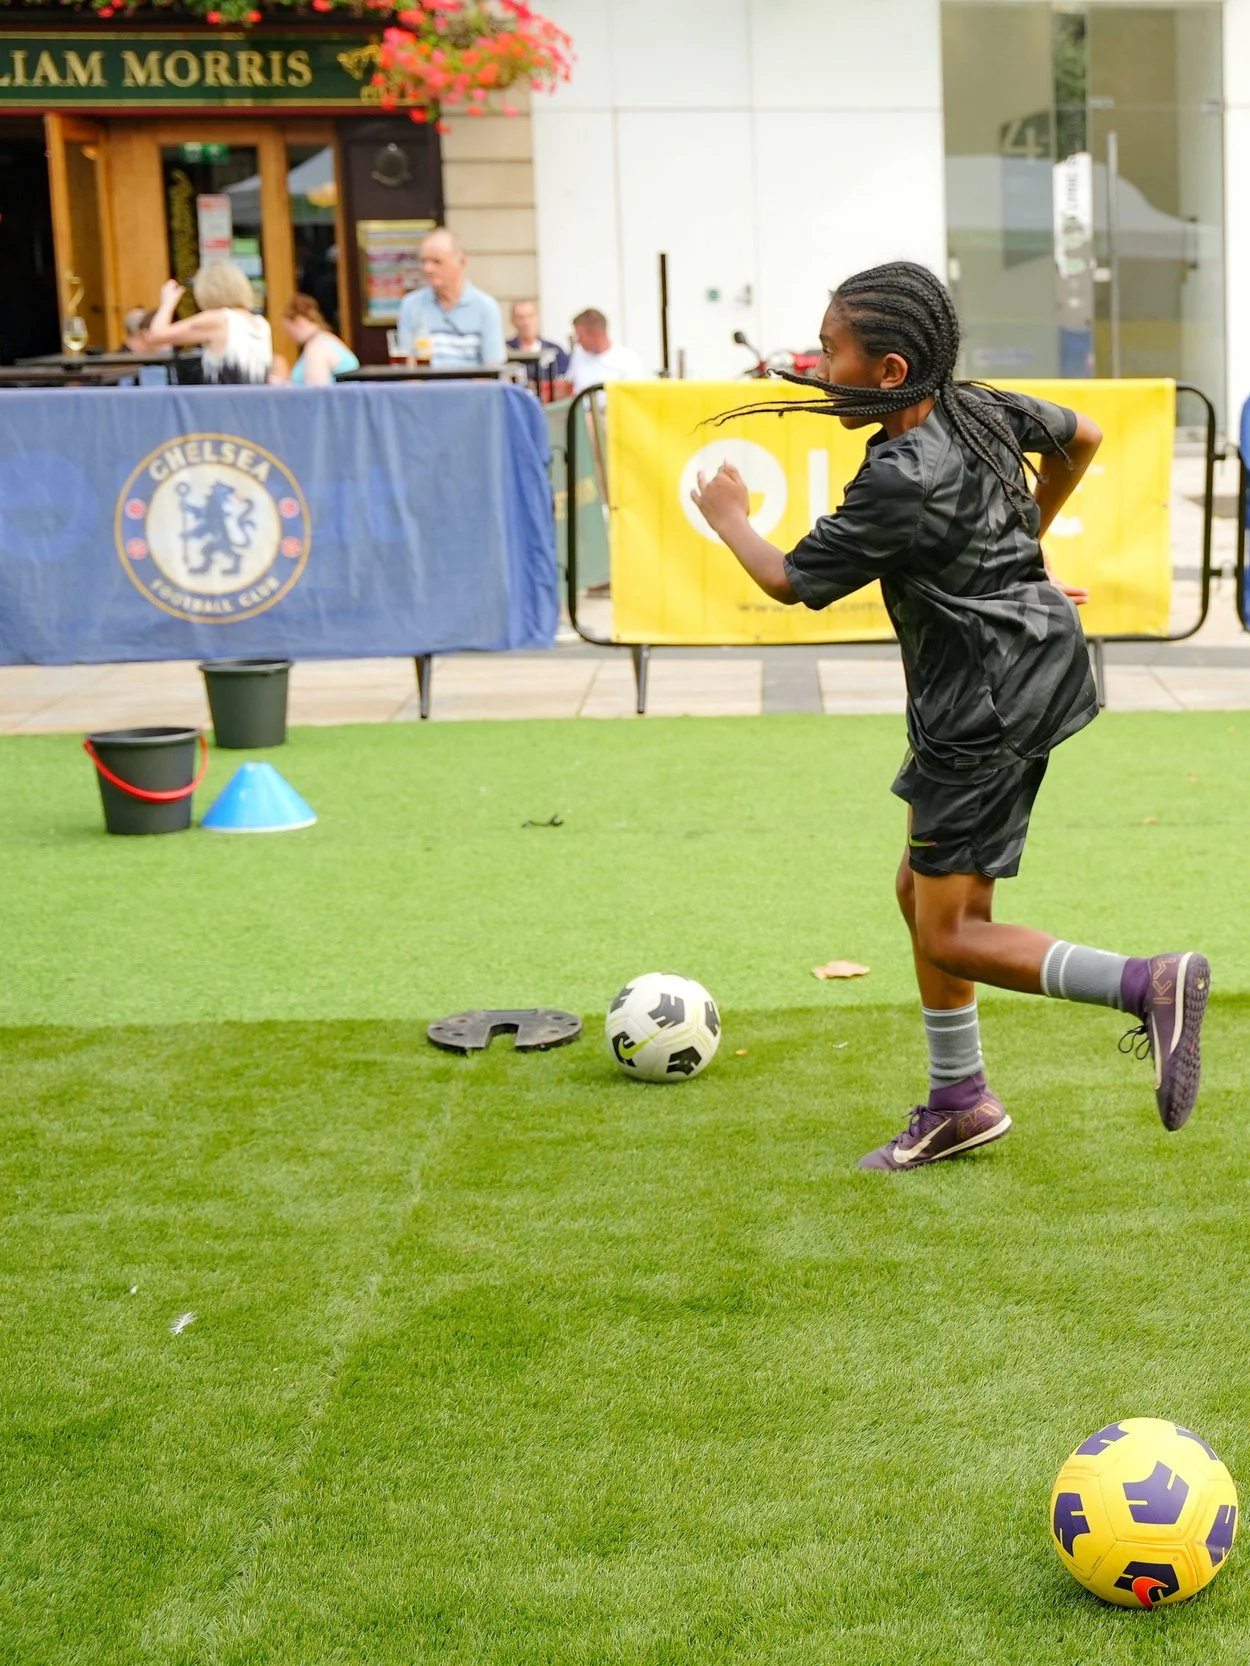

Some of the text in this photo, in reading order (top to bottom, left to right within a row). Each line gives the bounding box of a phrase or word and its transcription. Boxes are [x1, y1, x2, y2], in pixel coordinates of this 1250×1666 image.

[121, 49, 313, 88] MORRIS
[148, 440, 273, 482] CHELSEA
[151, 575, 281, 613] FOOTBALL CLUB
